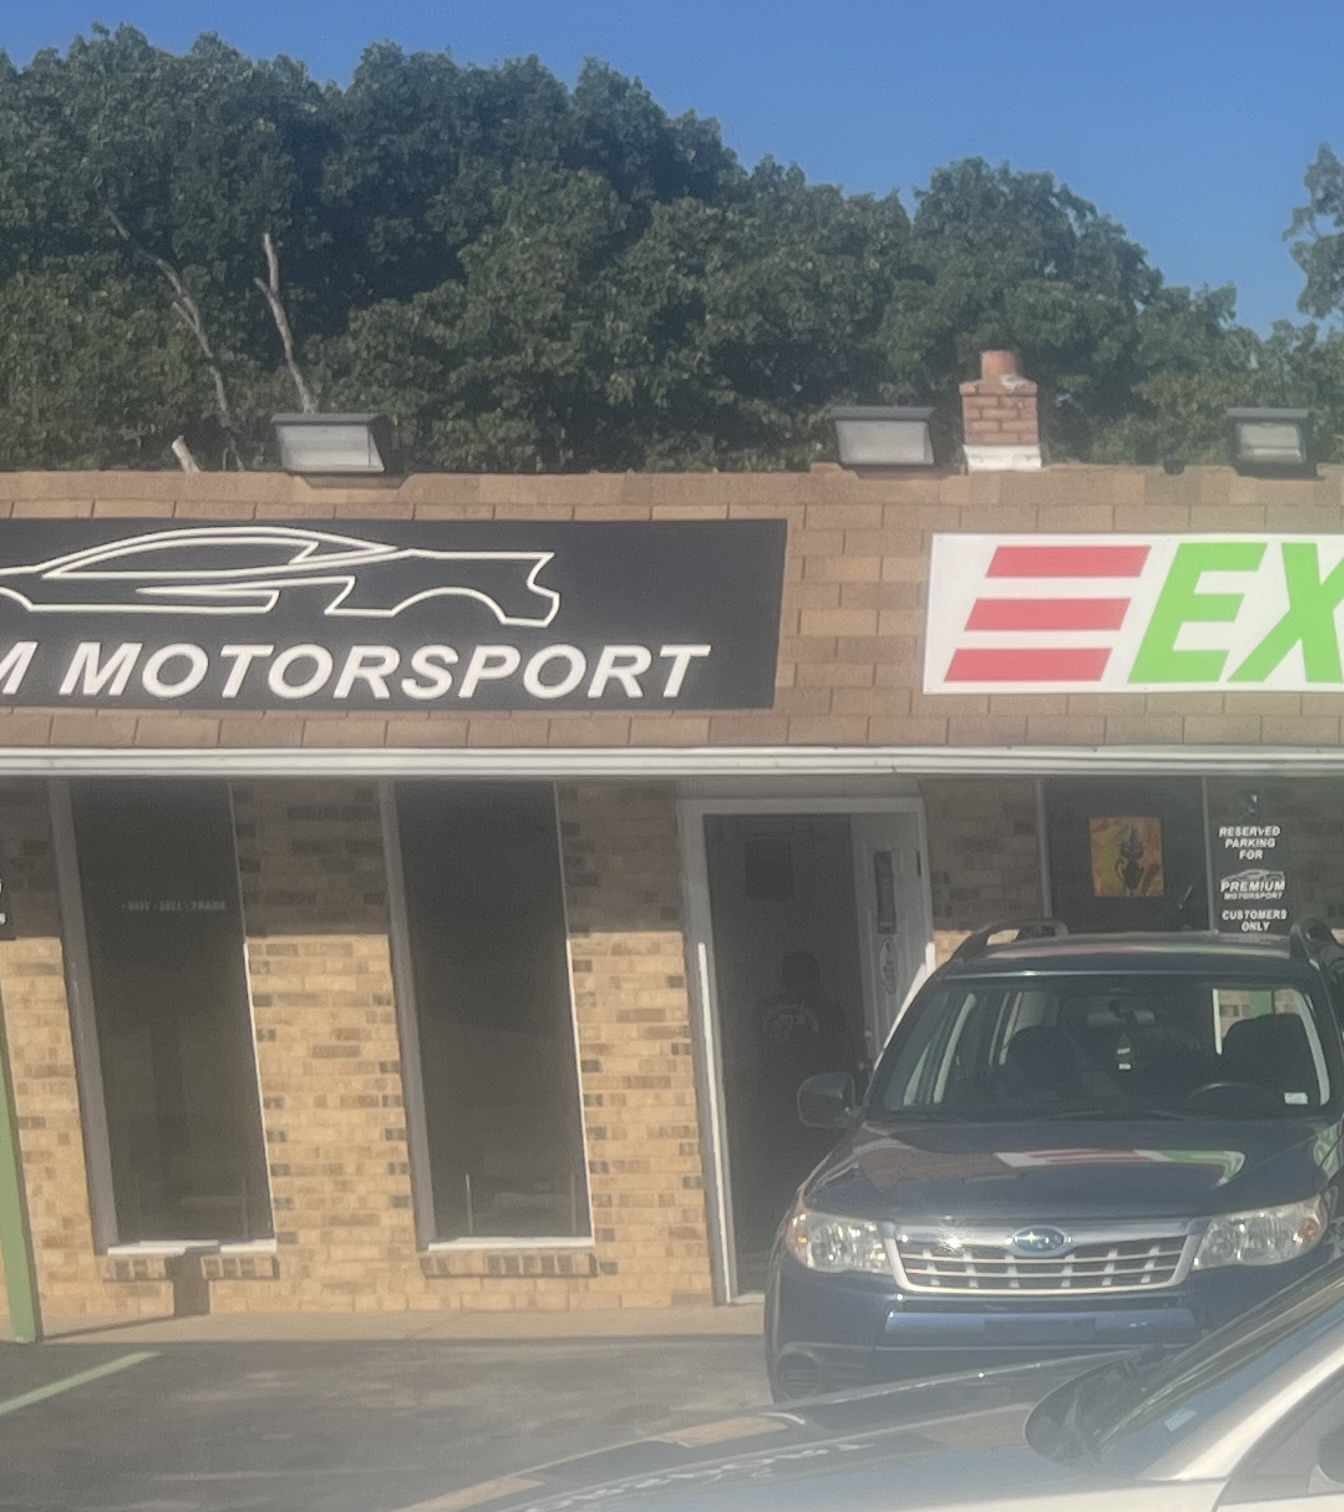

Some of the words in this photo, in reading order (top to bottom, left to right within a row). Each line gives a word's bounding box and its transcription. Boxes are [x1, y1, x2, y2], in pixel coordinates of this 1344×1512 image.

[57, 641, 713, 700] MOTORSPORT
[1219, 826, 1281, 837] RESERVED
[1225, 838, 1276, 849] PARKING
[1239, 849, 1263, 860] FOR
[1221, 880, 1286, 892] PREMIUM
[1224, 891, 1283, 900] MOTORSPORT
[1222, 909, 1288, 921] CUSTOMERS
[1241, 921, 1270, 932] ONLY
